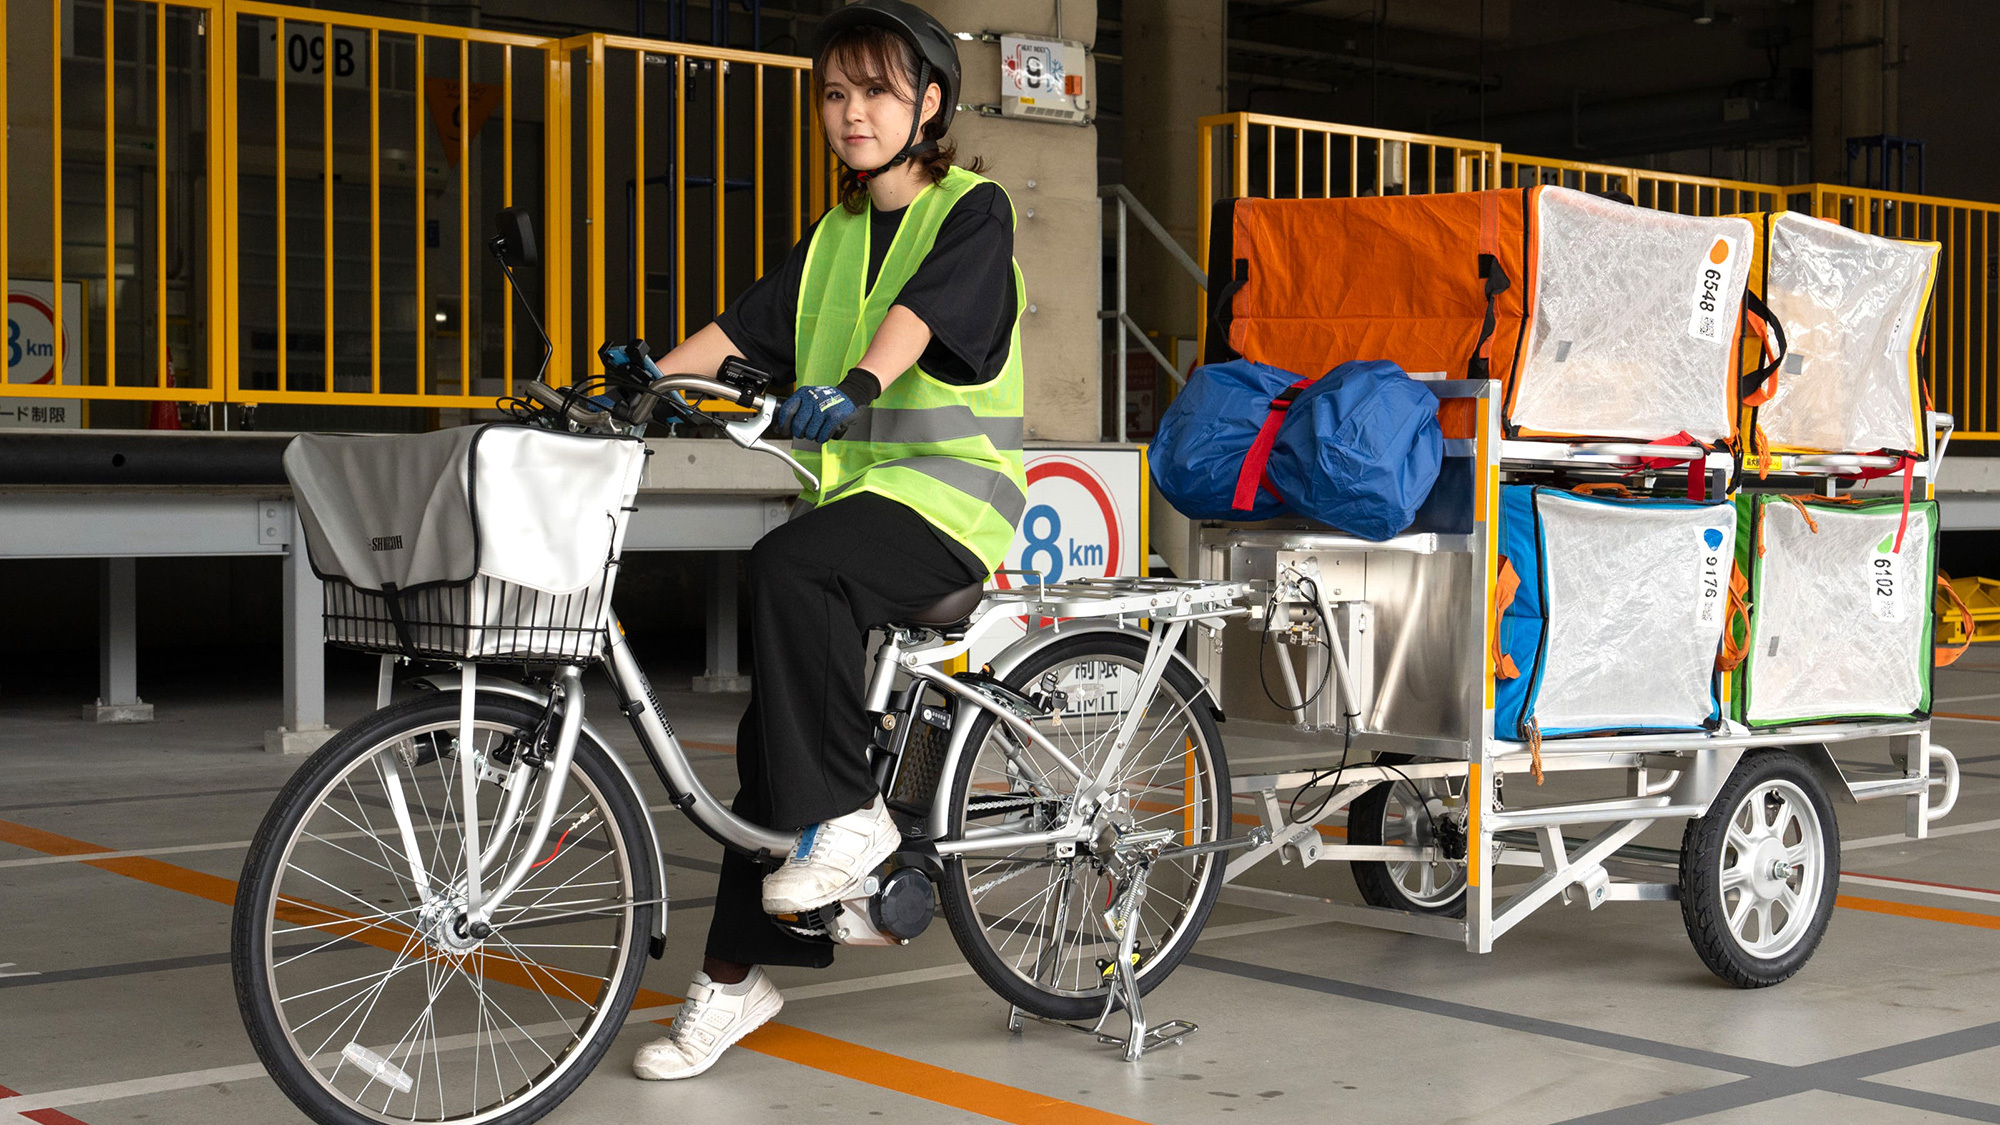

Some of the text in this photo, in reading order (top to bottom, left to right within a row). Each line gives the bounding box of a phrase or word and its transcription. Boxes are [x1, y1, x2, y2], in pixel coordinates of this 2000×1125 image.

[271, 33, 355, 77] 09B
[1699, 269, 1721, 312] 6548
[26, 338, 53, 356] km
[1021, 504, 1103, 586] 8 km
[1703, 556, 1718, 598] 9176
[1874, 559, 1893, 597] 6102
